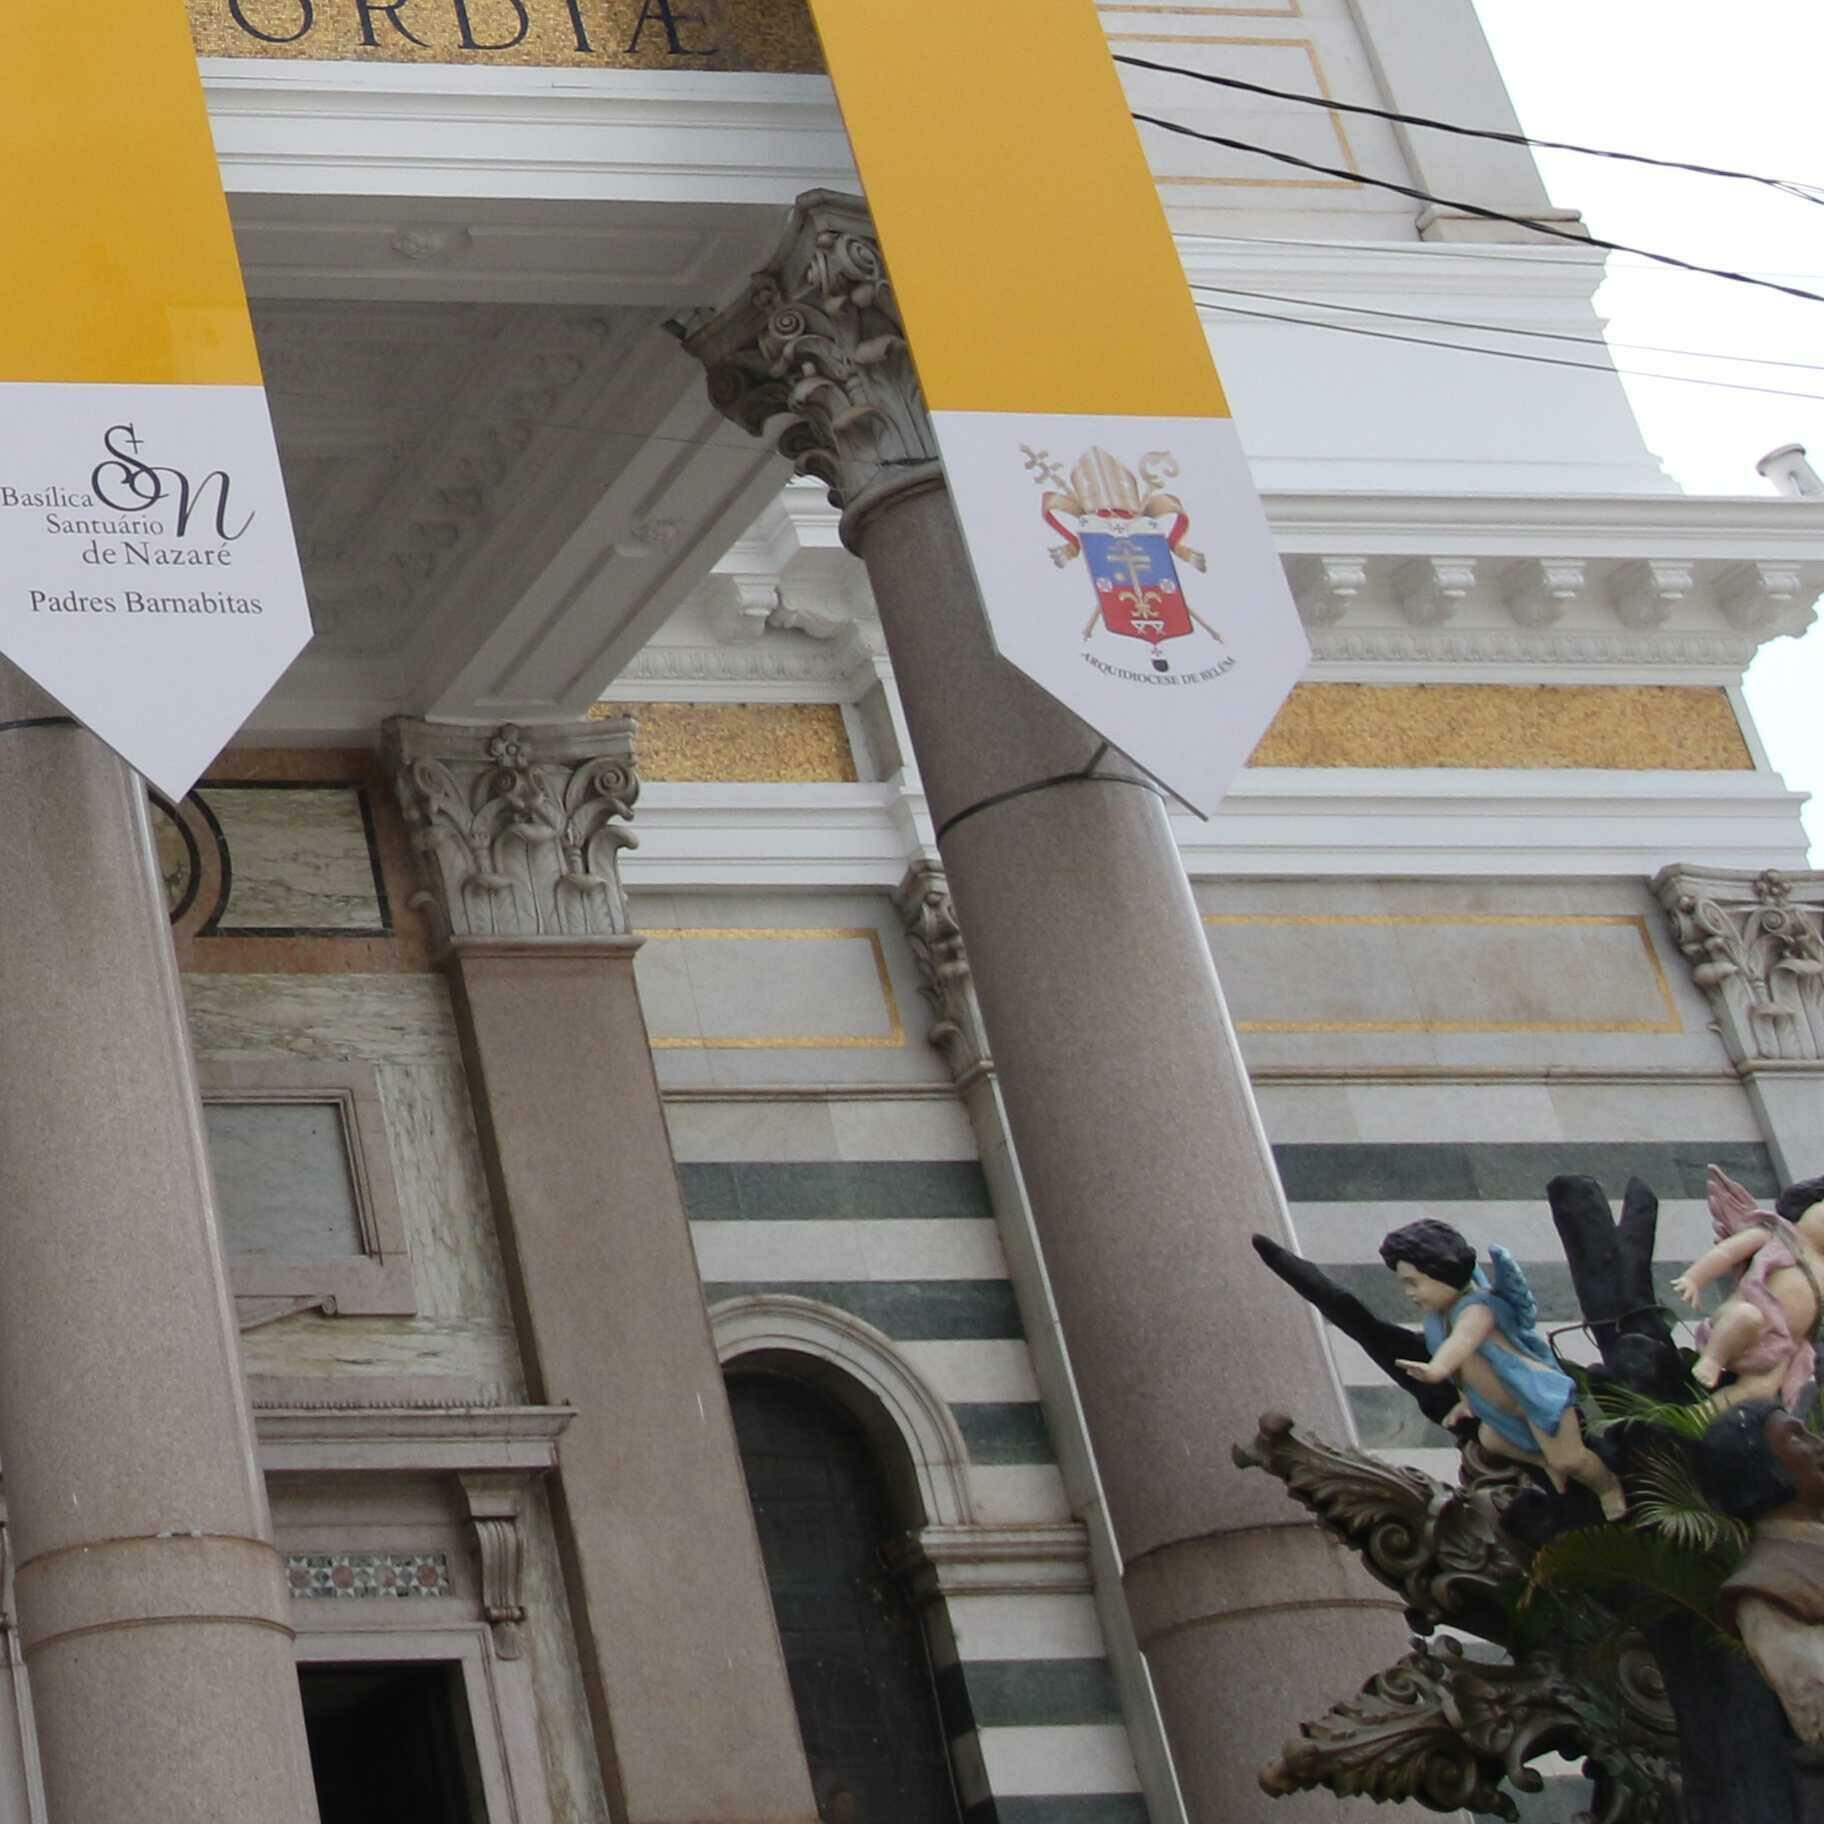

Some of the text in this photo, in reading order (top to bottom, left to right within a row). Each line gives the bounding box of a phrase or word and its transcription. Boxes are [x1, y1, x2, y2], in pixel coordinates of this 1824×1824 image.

[0, 485, 94, 508] Basílica
[47, 513, 164, 536] Santuário
[82, 540, 232, 566] de Nazaré
[28, 590, 263, 615] Padres Barnabitas
[1081, 651, 1180, 685] ARQUIDIOCESE
[1182, 674, 1199, 685] DE
